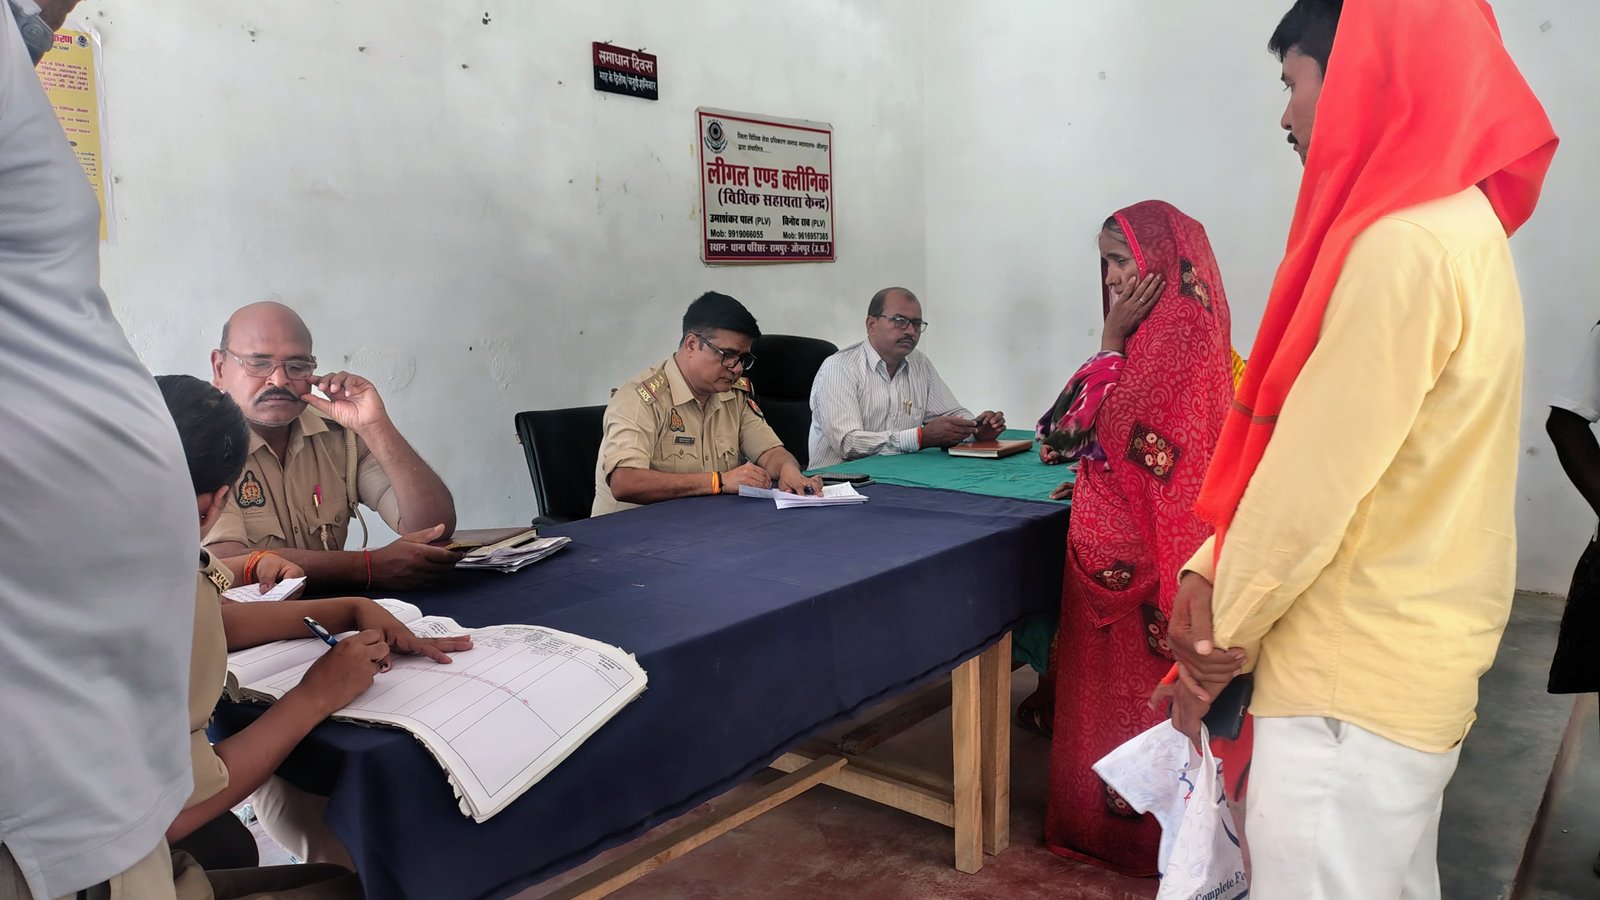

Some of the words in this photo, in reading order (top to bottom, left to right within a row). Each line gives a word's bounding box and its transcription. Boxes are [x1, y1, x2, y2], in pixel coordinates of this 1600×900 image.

[598, 50, 629, 68] समाधान
[631, 53, 653, 73] दिवस
[706, 157, 749, 187] लीगल
[752, 166, 779, 189] एण्ड
[781, 165, 829, 193] क्लीनिक
[718, 187, 761, 207] (विधिक
[762, 193, 802, 209] सहायता
[803, 193, 829, 213] केन्द्र)
[709, 211, 738, 224] उमाशंकर
[739, 215, 753, 225] पाल
[754, 216, 771, 228] (PLV)
[811, 219, 826, 229] (PLV)
[710, 228, 727, 238] Mob:
[727, 229, 764, 239] 9919066055
[782, 231, 797, 240] Mob:
[730, 242, 746, 252] थाना
[1195, 879, 1234, 900] Complete
